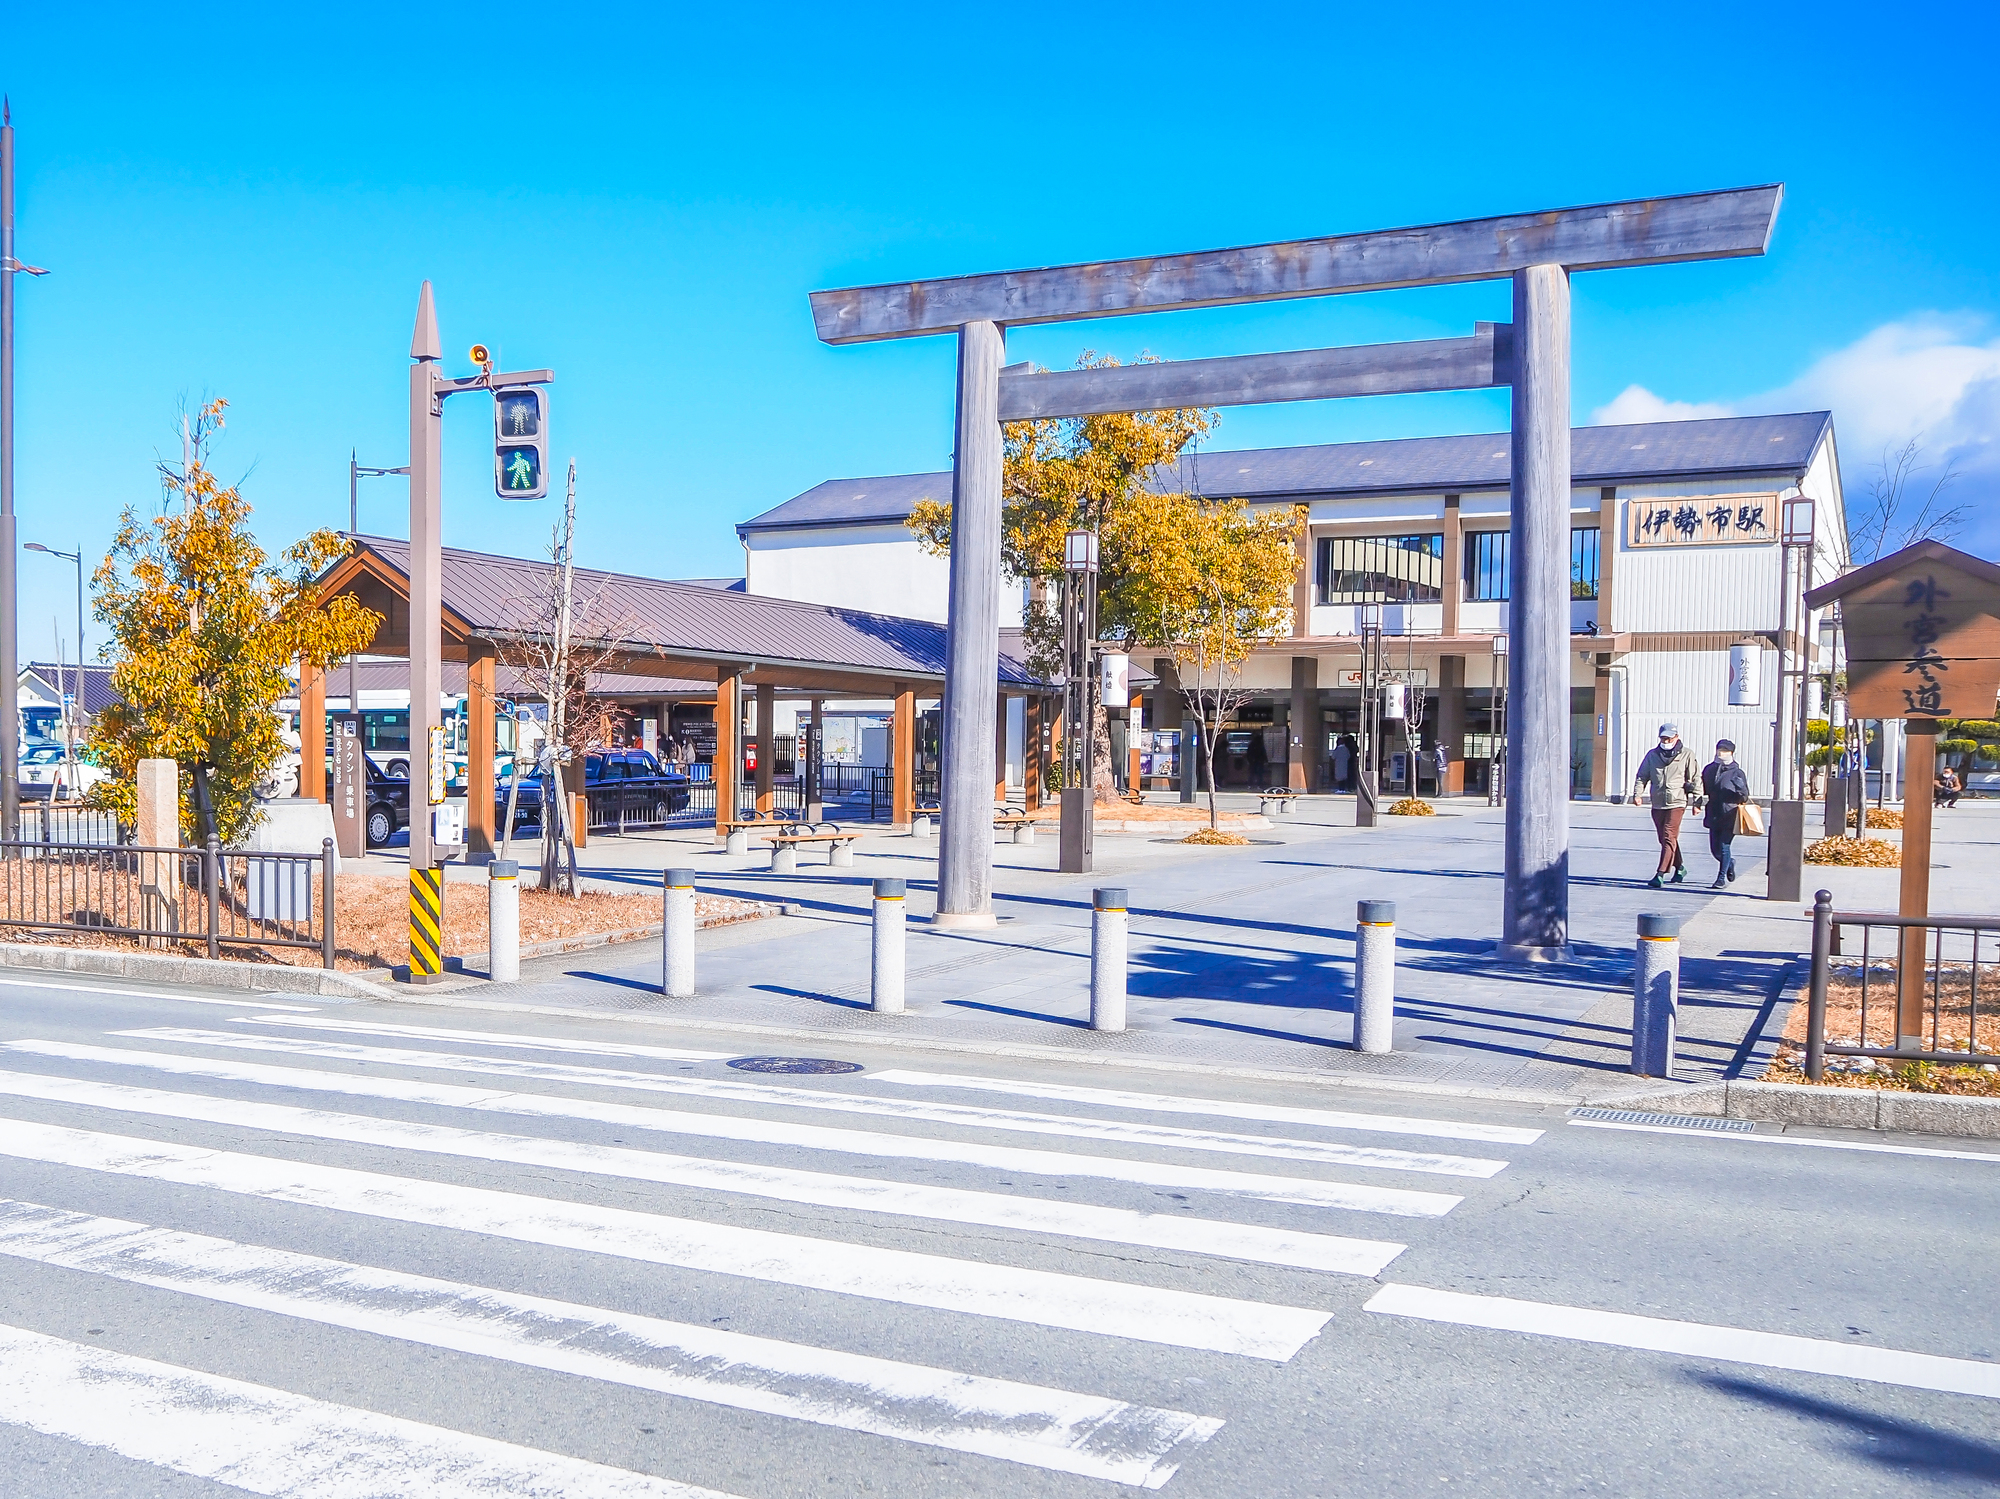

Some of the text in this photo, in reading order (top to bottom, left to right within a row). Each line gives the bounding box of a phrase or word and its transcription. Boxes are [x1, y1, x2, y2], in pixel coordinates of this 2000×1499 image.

[1641, 504, 1766, 537] 伊勢市駅
[1901, 575, 1952, 716] 外宮参道
[346, 740, 355, 819] タクシー乗車場
